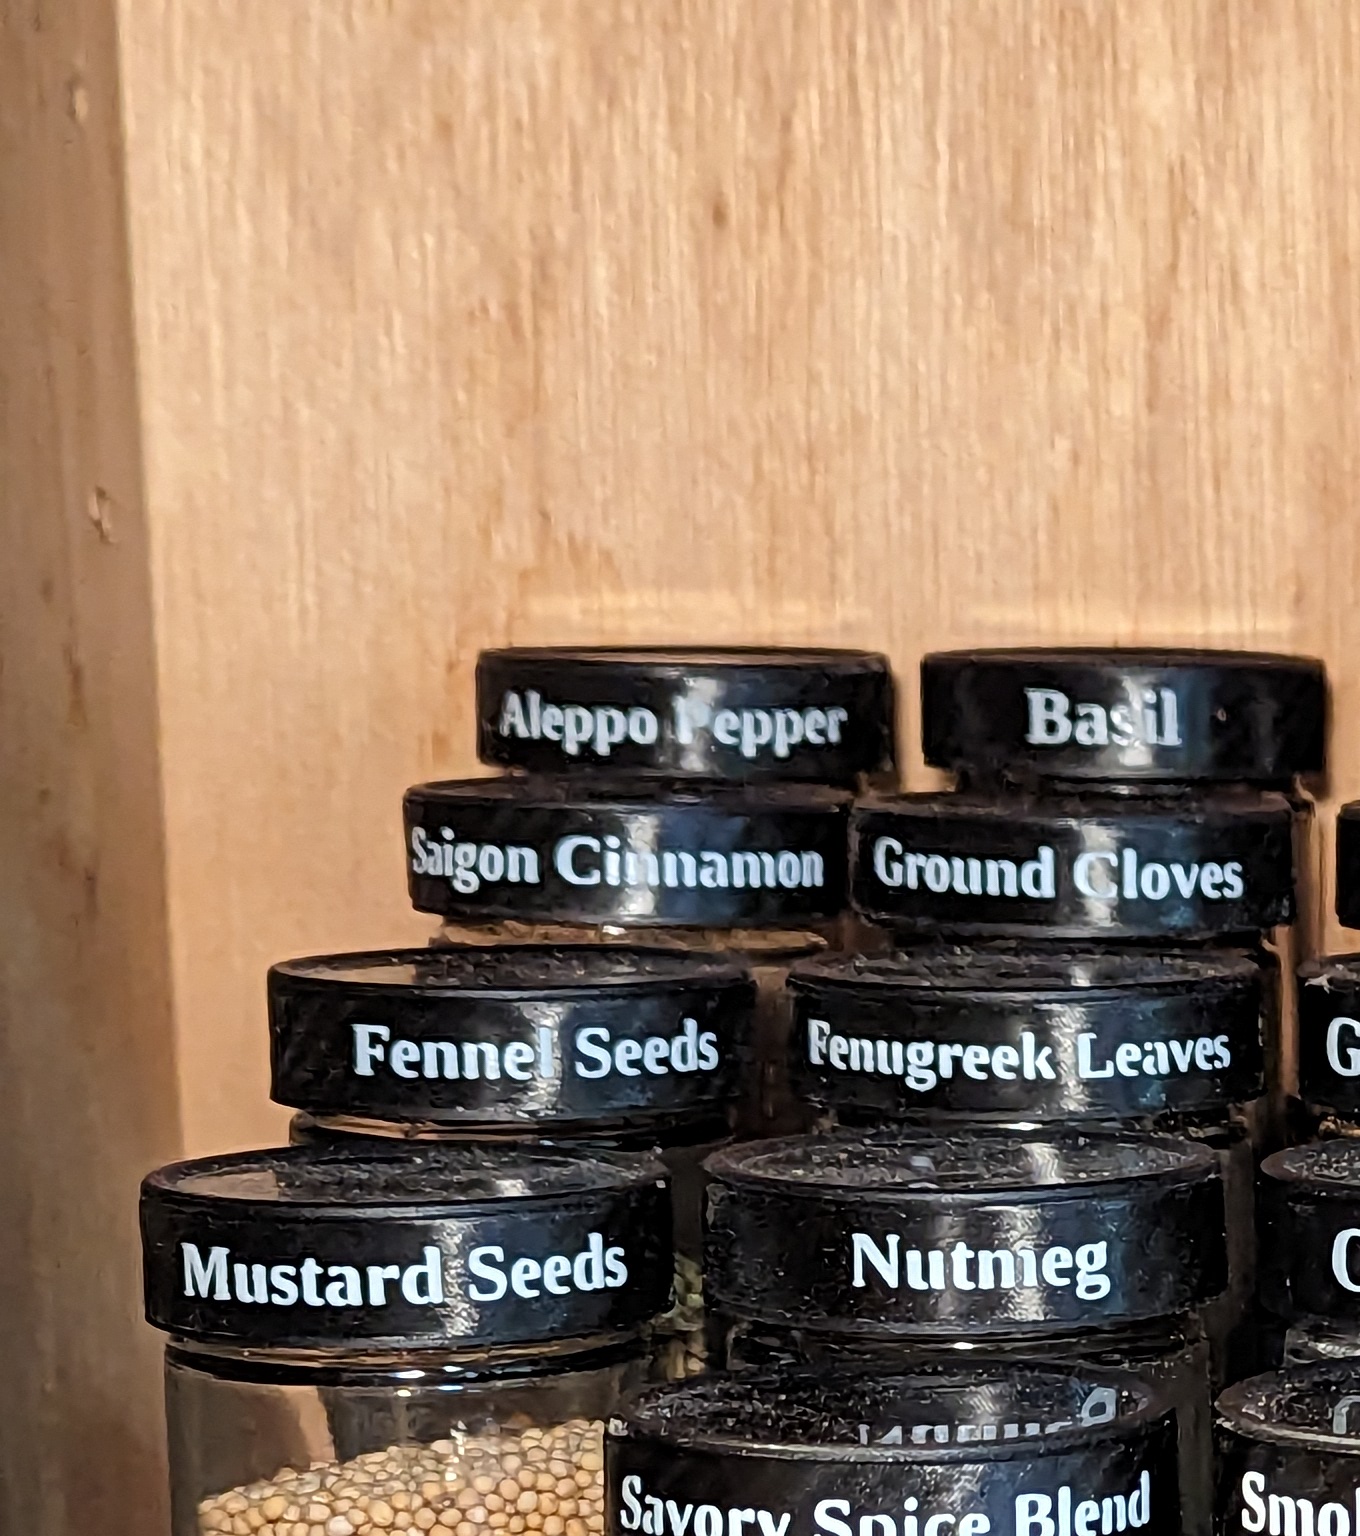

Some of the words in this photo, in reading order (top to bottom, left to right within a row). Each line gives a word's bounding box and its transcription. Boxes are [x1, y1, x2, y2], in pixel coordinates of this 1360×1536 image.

[500, 688, 658, 756] Aleppo
[673, 694, 849, 757] Pepper
[1025, 687, 1183, 748] Basil
[410, 826, 540, 892] Saigon
[553, 835, 824, 888] Cinnamon
[874, 837, 1054, 898] Ground
[1074, 848, 1244, 900] Cloves
[352, 1025, 554, 1081] Fennel
[574, 1018, 720, 1079] Seeds
[807, 1019, 1057, 1091] Fenugreek
[1077, 1030, 1230, 1079] Leaves
[180, 1240, 443, 1306] Mustard
[466, 1233, 629, 1302] Seeds
[850, 1233, 1110, 1301] Nutmeg
